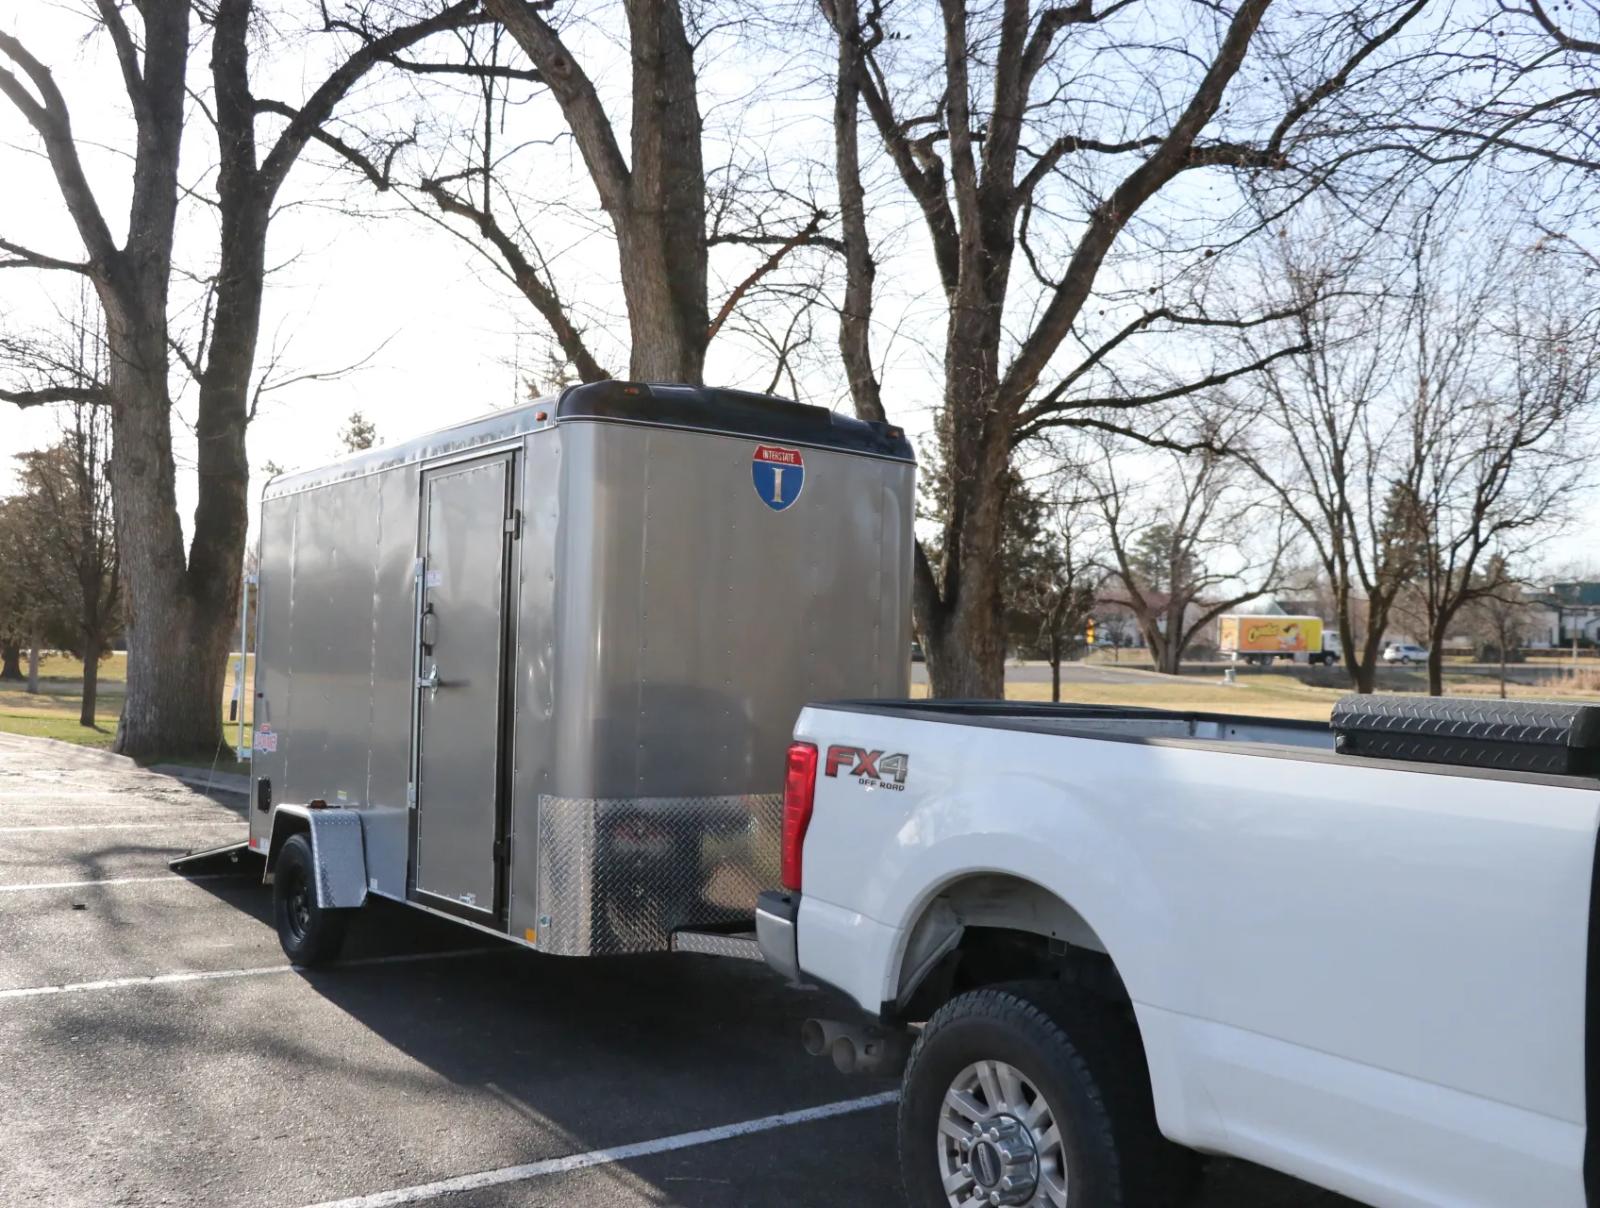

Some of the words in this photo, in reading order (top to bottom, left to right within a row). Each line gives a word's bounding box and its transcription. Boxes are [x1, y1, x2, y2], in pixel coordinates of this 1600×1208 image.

[762, 449, 795, 463] INTERSTATE
[825, 744, 909, 783] FX4
[858, 778, 877, 786] OFF
[879, 782, 905, 792] ROAD
